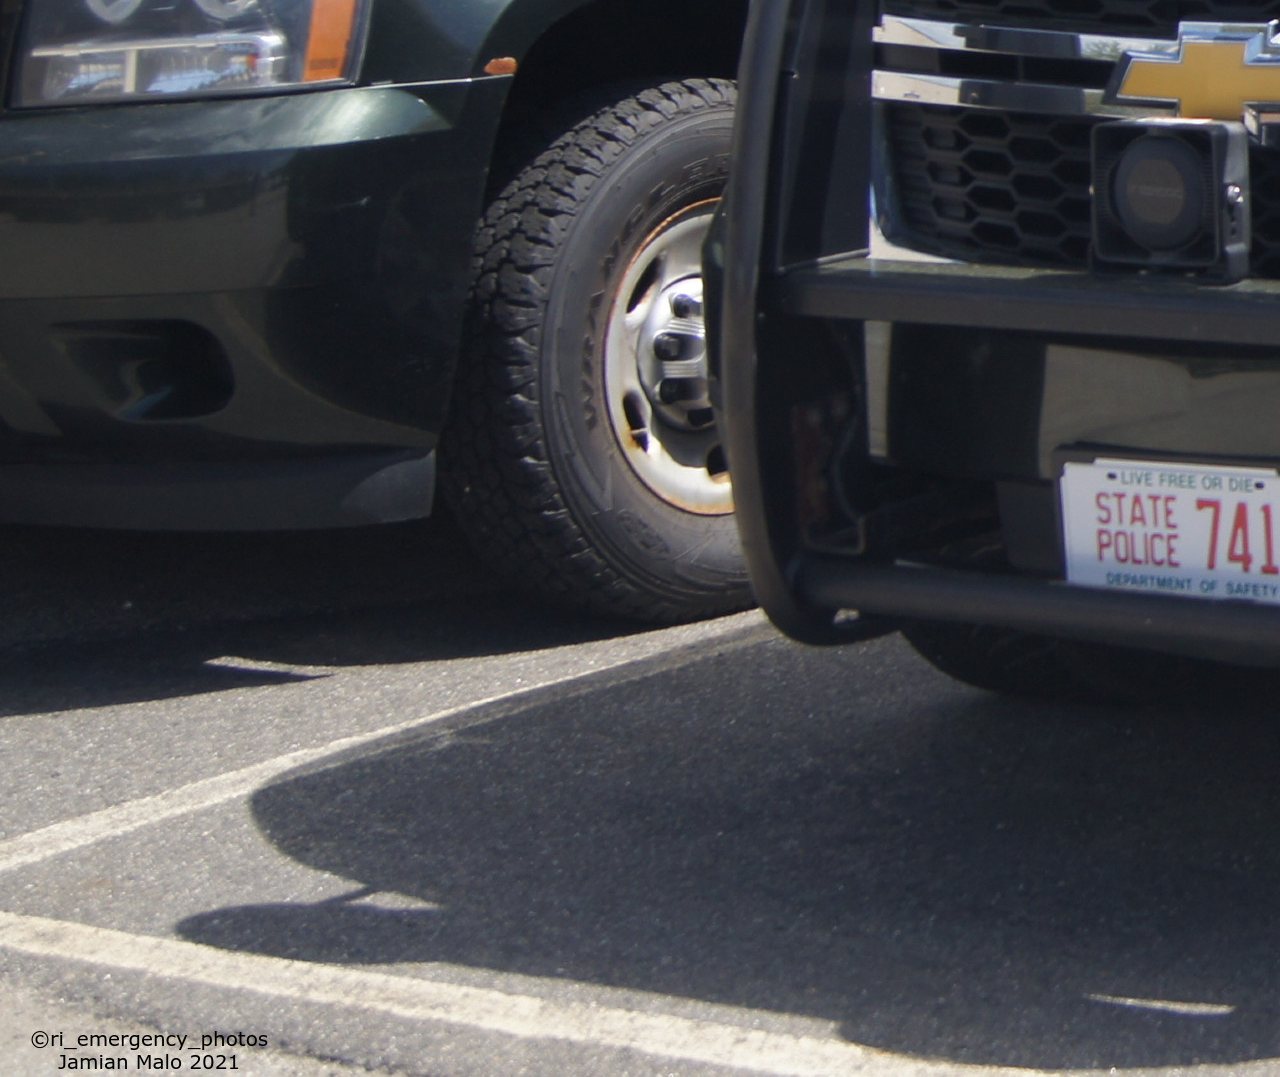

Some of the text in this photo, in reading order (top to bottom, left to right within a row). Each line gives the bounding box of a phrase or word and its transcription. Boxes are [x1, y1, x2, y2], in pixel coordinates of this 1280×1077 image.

[1120, 470, 1254, 493] LIVE FREE OR DIE
[1095, 492, 1178, 530] STATE
[1096, 528, 1182, 568] POLICE
[1195, 496, 1280, 576] 741
[1105, 571, 1280, 598] DEPARTMENT OF SAFETY
